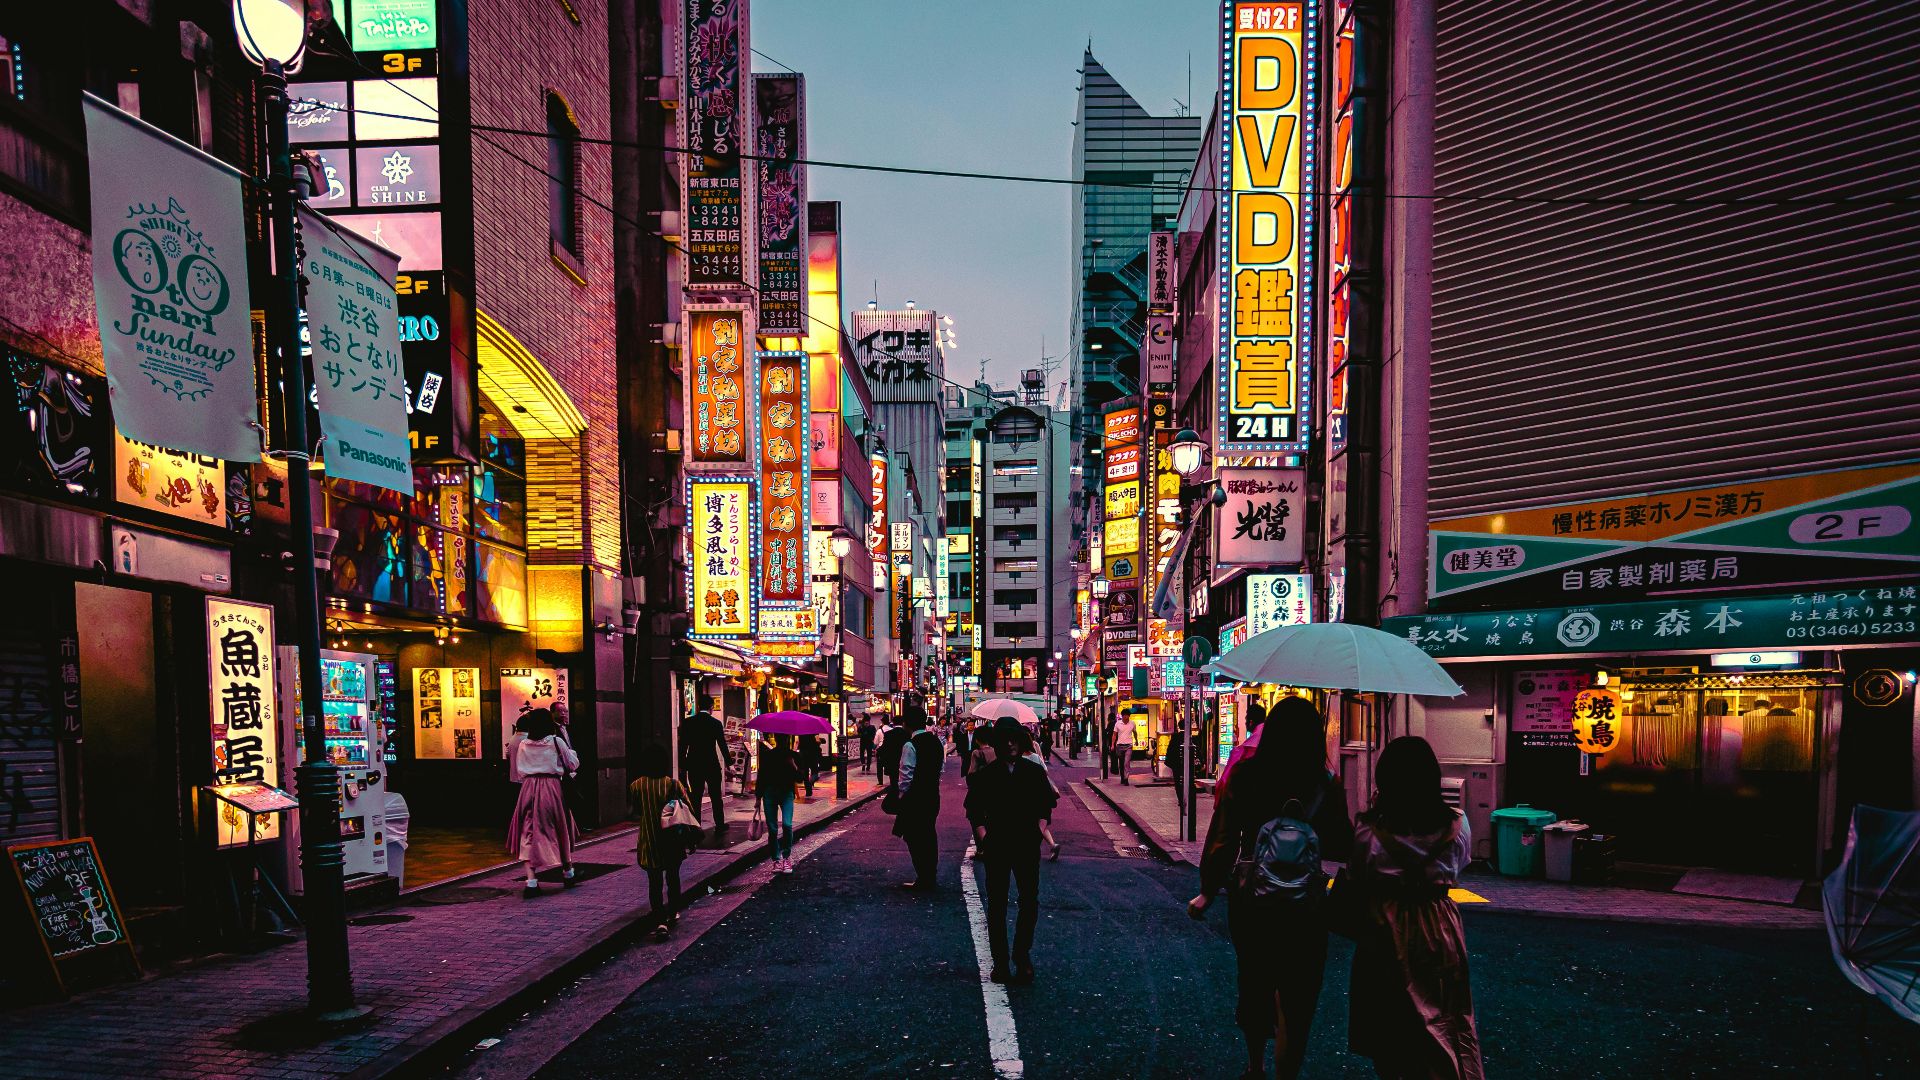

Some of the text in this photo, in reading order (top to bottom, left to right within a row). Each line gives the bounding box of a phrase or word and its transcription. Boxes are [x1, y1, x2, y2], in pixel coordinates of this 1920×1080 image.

[1239, 8, 1298, 30] 受付2F
[689, 0, 702, 89] まくらみみかき
[383, 53, 422, 73] 3F
[689, 178, 740, 188] 新宿東口店
[371, 191, 427, 203] SHINE
[701, 205, 737, 215] 3341
[1235, 36, 1297, 409] DVD鑑賞
[690, 229, 740, 242] 五反田店
[692, 244, 740, 253] 山手線で6分
[702, 255, 740, 264] 3444
[310, 261, 391, 309] 6月第一日曜日は
[395, 275, 428, 294] 2F
[131, 293, 217, 336] nari
[337, 294, 380, 337] 渋谷
[114, 312, 236, 372] Sunday
[320, 324, 399, 376] おとなり
[322, 361, 402, 401] サンデー
[420, 374, 439, 409] 渋谷
[1108, 414, 1137, 427] カラオケ
[408, 431, 439, 449] 1F
[1121, 428, 1138, 437] ECHO
[338, 440, 407, 473] Panasonic
[1108, 450, 1137, 463] カラオケ
[1108, 487, 1137, 502] 腹八分目
[873, 465, 885, 548] カラオケ
[1552, 491, 1765, 535] 慢性病薬ホノミ漢方
[704, 492, 729, 576] 博多風龍
[729, 493, 740, 577] とんこつらーめん
[769, 537, 783, 594] 中国料理
[1450, 547, 1518, 571] 健美堂
[1562, 557, 1738, 591] 自家製剤薬局
[722, 589, 741, 625] 替玉
[1791, 587, 1916, 605] 元祖つくね焼
[705, 590, 723, 626] 無料
[1272, 606, 1289, 627] 森
[1790, 604, 1917, 622] お土産承ります
[760, 620, 794, 628] 博多風龍
[1491, 613, 1538, 630] うなぎ
[1610, 618, 1644, 631] 渋谷
[1653, 605, 1743, 637] 森本
[1786, 622, 1915, 639] 03(3464)5233
[1106, 630, 1136, 639] DVD鑑賞
[1407, 625, 1470, 645] 喜久水
[1485, 631, 1534, 646] 焼鳥
[60, 636, 80, 733] 市橋ビル
[220, 627, 265, 782] 魚蔵居
[1587, 696, 1616, 747] 焼鳥
[25, 865, 60, 892] NORTH
[48, 914, 69, 925] FREE
